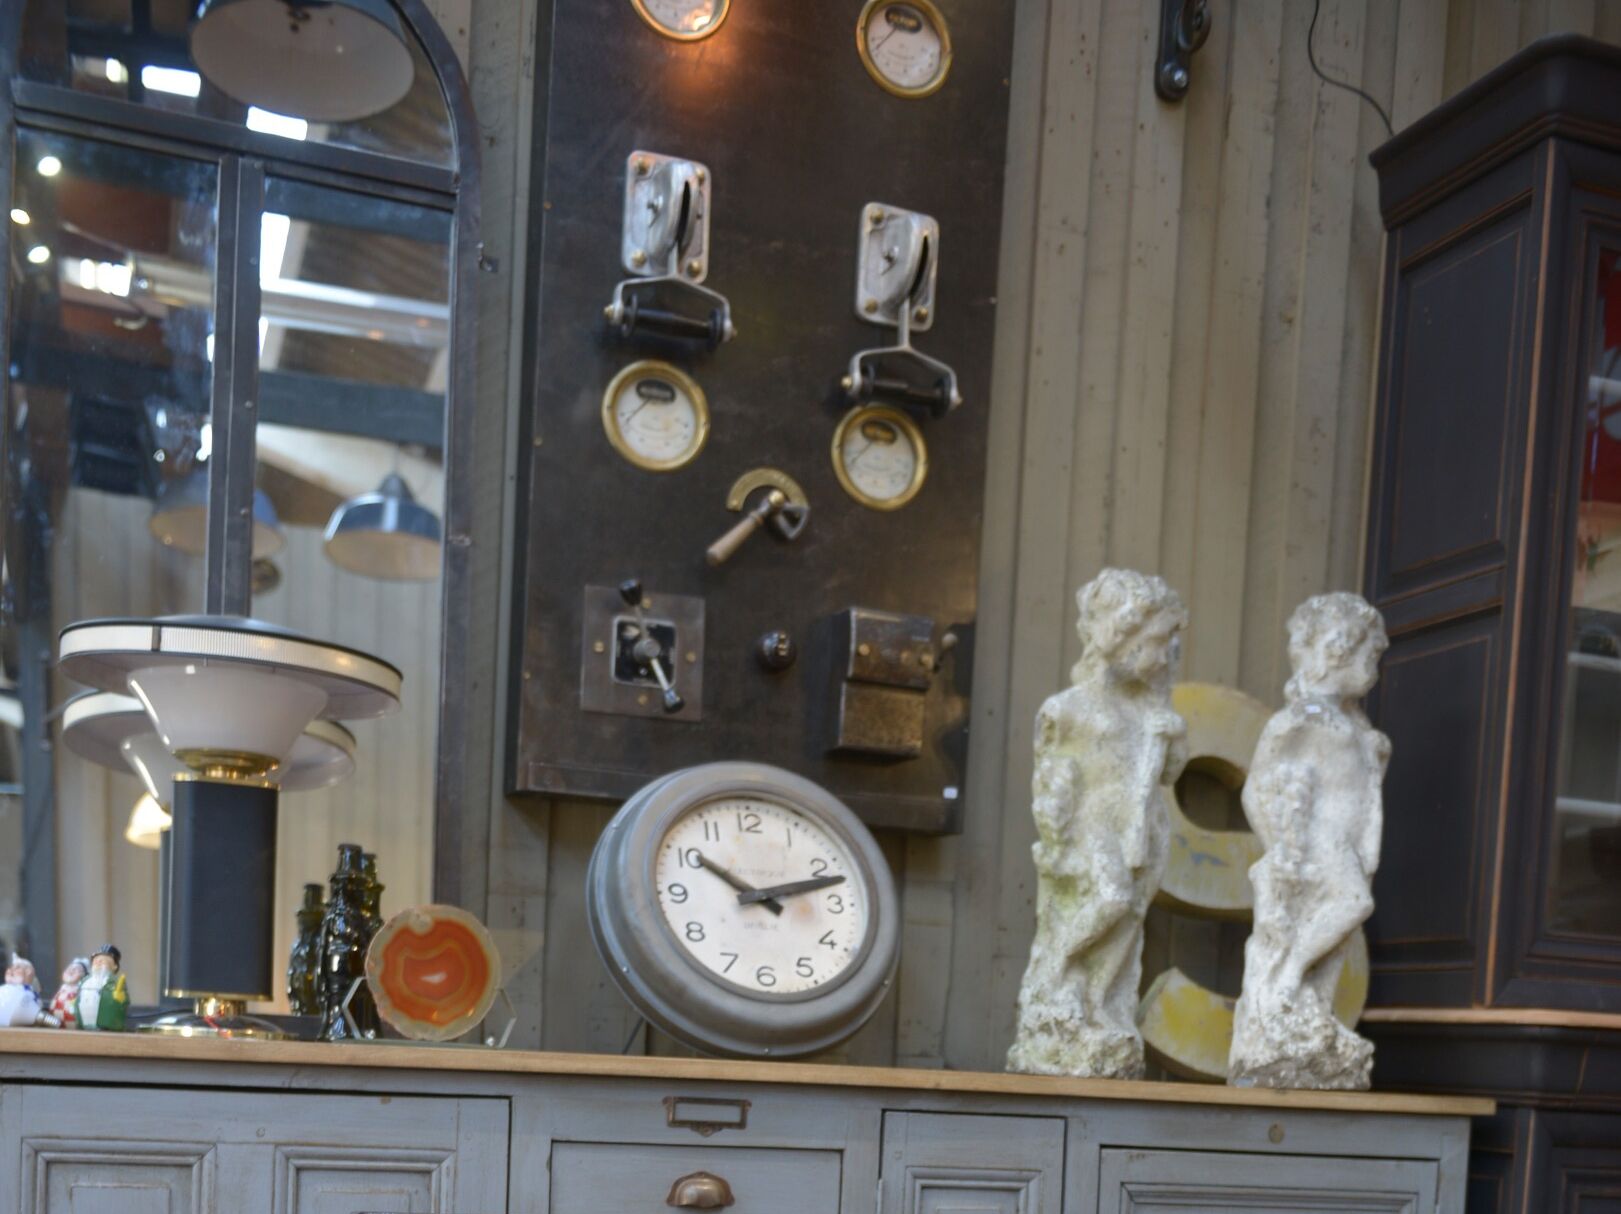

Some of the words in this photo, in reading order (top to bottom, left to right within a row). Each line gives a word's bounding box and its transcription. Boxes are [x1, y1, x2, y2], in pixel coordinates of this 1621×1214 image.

[703, 820, 720, 842] 11
[737, 812, 763, 834] 12
[786, 827, 792, 848] 1
[677, 847, 704, 869] 10
[809, 858, 829, 878] 2
[667, 883, 688, 904] 9
[826, 894, 844, 914] 3
[685, 922, 706, 942] 8
[819, 930, 837, 950] 4
[720, 952, 739, 973] 7
[796, 957, 814, 978] 5
[756, 966, 777, 987] 6
